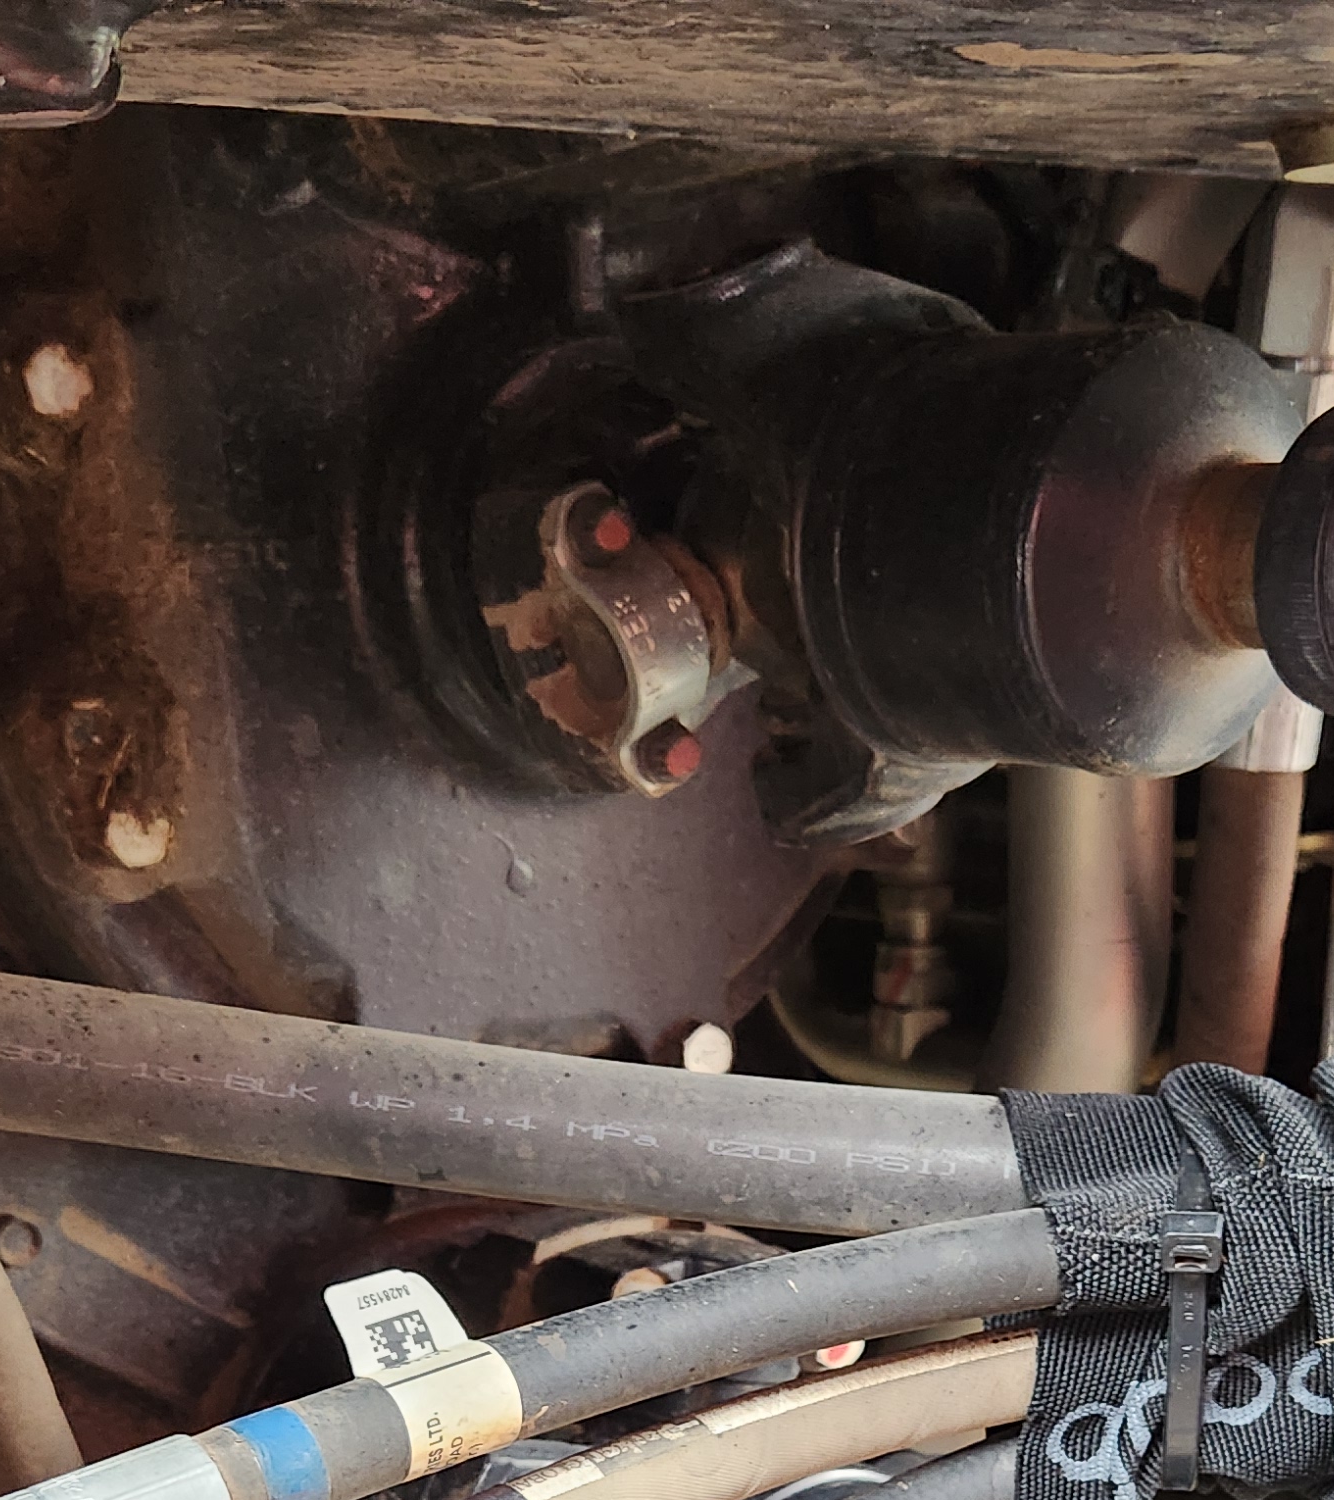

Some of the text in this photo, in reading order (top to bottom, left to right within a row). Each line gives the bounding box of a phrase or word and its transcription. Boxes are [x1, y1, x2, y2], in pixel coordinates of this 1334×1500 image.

[349, 1091, 417, 1112] WP
[447, 1105, 537, 1132] 1.4
[568, 1121, 660, 1148] MPa
[357, 1284, 411, 1311] 84281557
[426, 1411, 444, 1452] LTD.
